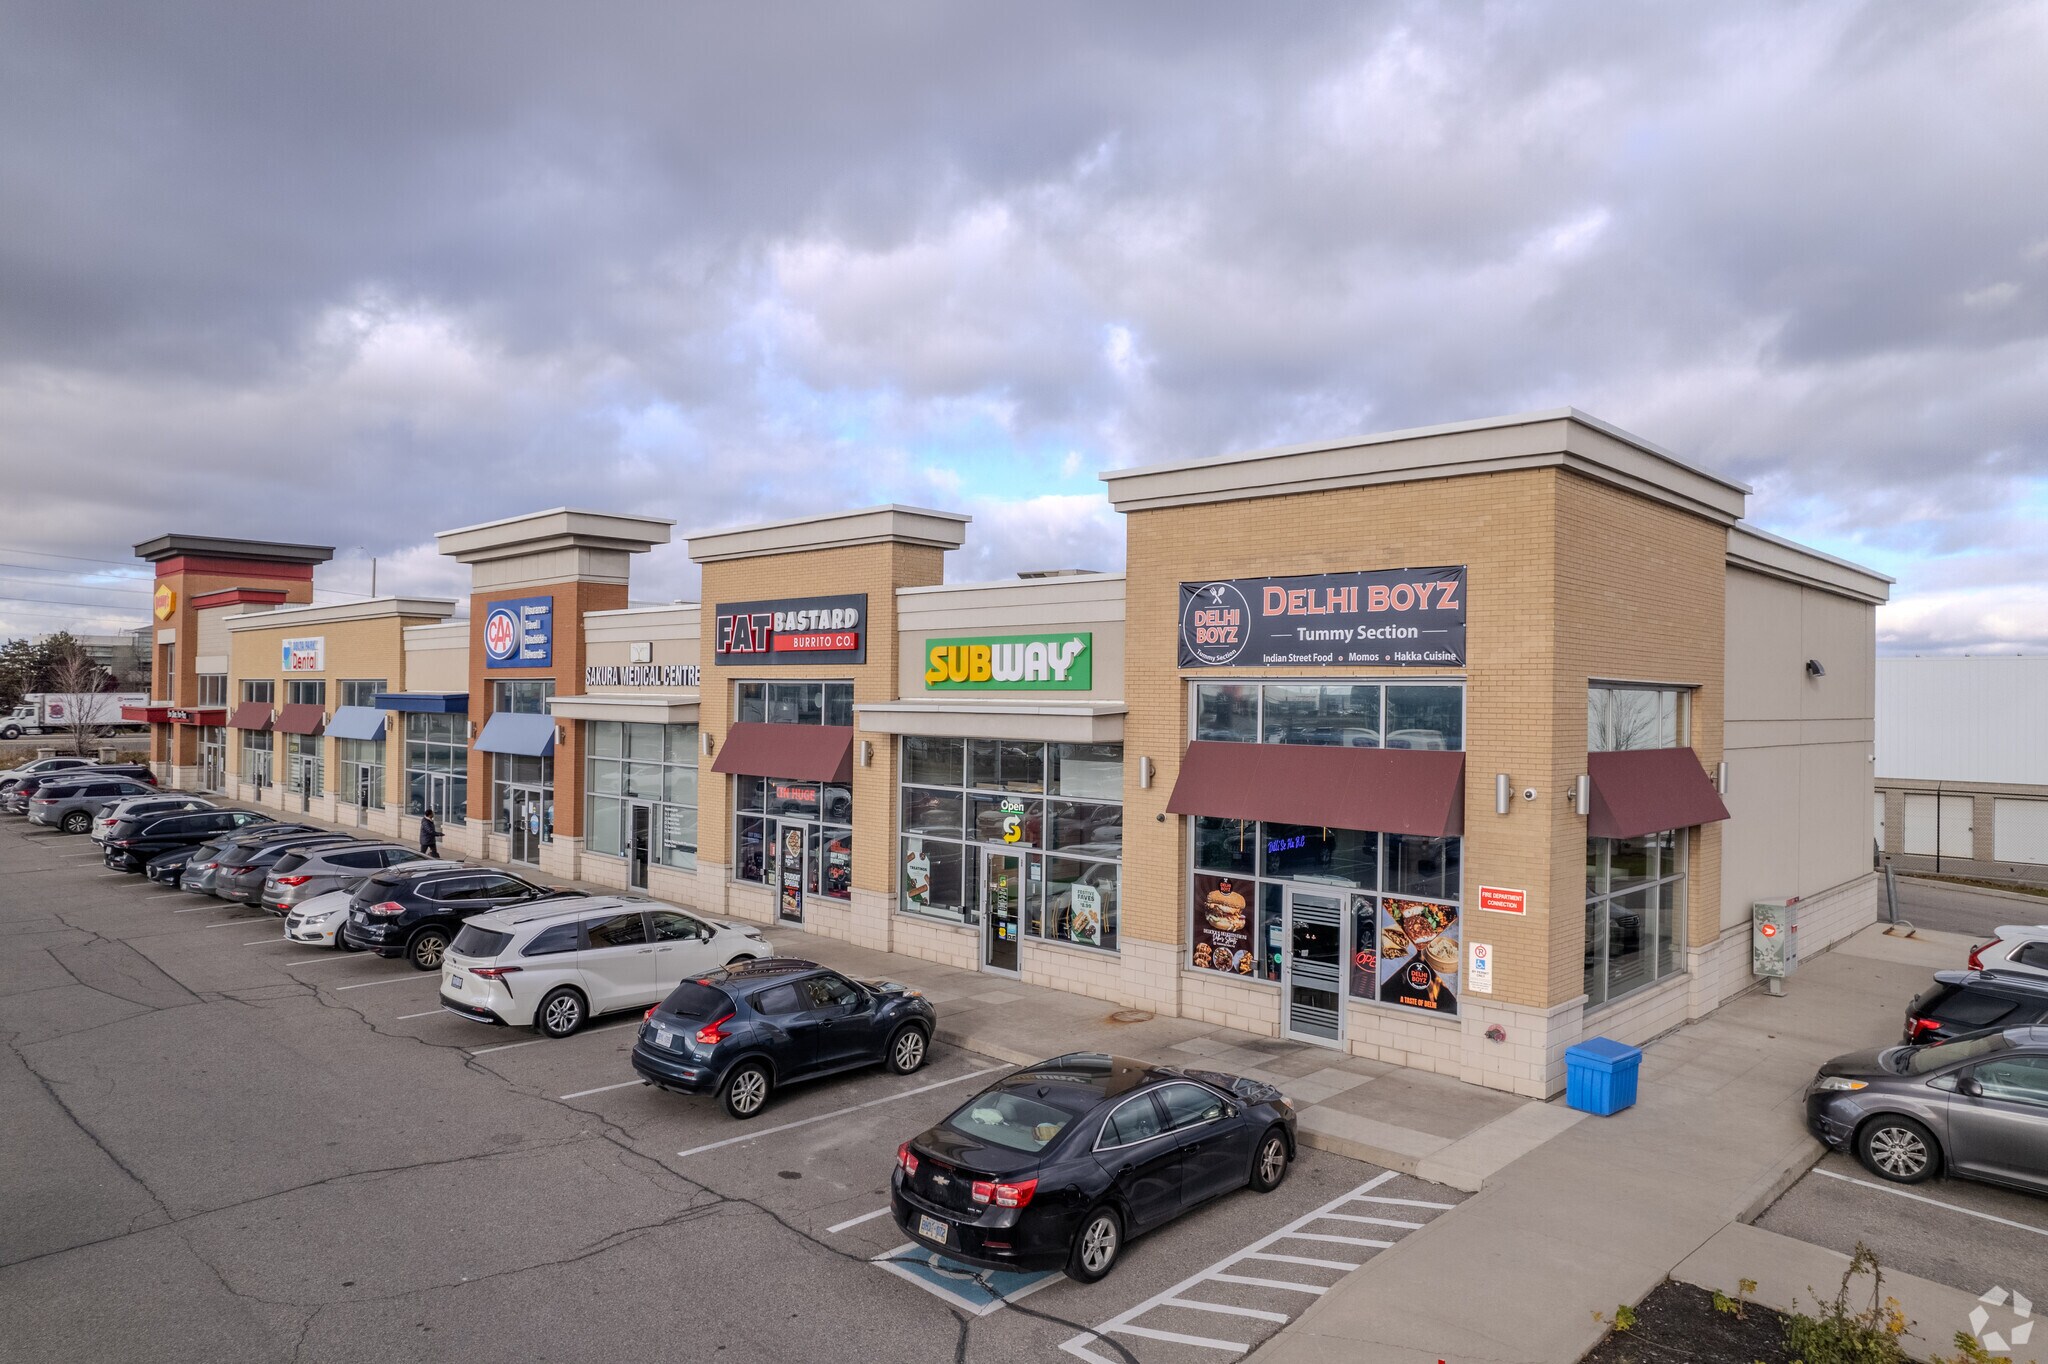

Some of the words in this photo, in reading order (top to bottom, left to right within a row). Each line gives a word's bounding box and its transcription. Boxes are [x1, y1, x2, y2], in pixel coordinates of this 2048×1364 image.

[1263, 585, 1358, 616] DELHI
[1367, 581, 1459, 612] BOYZ
[774, 608, 858, 632] BASTARD
[1194, 609, 1240, 627] DELHI
[489, 616, 512, 650] CAA
[717, 613, 774, 653] FAT
[1196, 627, 1238, 644] BOYZ
[1297, 627, 1354, 643] Tummy
[1357, 625, 1418, 640] Section
[794, 636, 832, 647] BURRITO
[836, 636, 853, 646] CO.
[293, 652, 316, 670] Dental
[925, 637, 1086, 686] SUBWAY
[1197, 649, 1215, 662] Tummy
[1216, 650, 1236, 660] Section
[1263, 654, 1286, 663] Indian
[1288, 654, 1312, 662] Street
[1314, 653, 1332, 662] Food
[1349, 652, 1379, 662] Momos
[1394, 652, 1422, 661] Hakka
[1424, 652, 1456, 660] Cuisine
[586, 666, 620, 686] SAKURA
[621, 666, 662, 686] MEDICAL
[664, 666, 700, 686] CENTRE
[792, 788, 816, 801] HUGE
[1001, 800, 1024, 812] Open
[1488, 900, 1517, 908] CONNECTION
[1357, 952, 1376, 967] OPE
[1411, 970, 1428, 978] DELHI
[1404, 997, 1417, 1005] TASTE
[1424, 1000, 1437, 1008] DELHI
